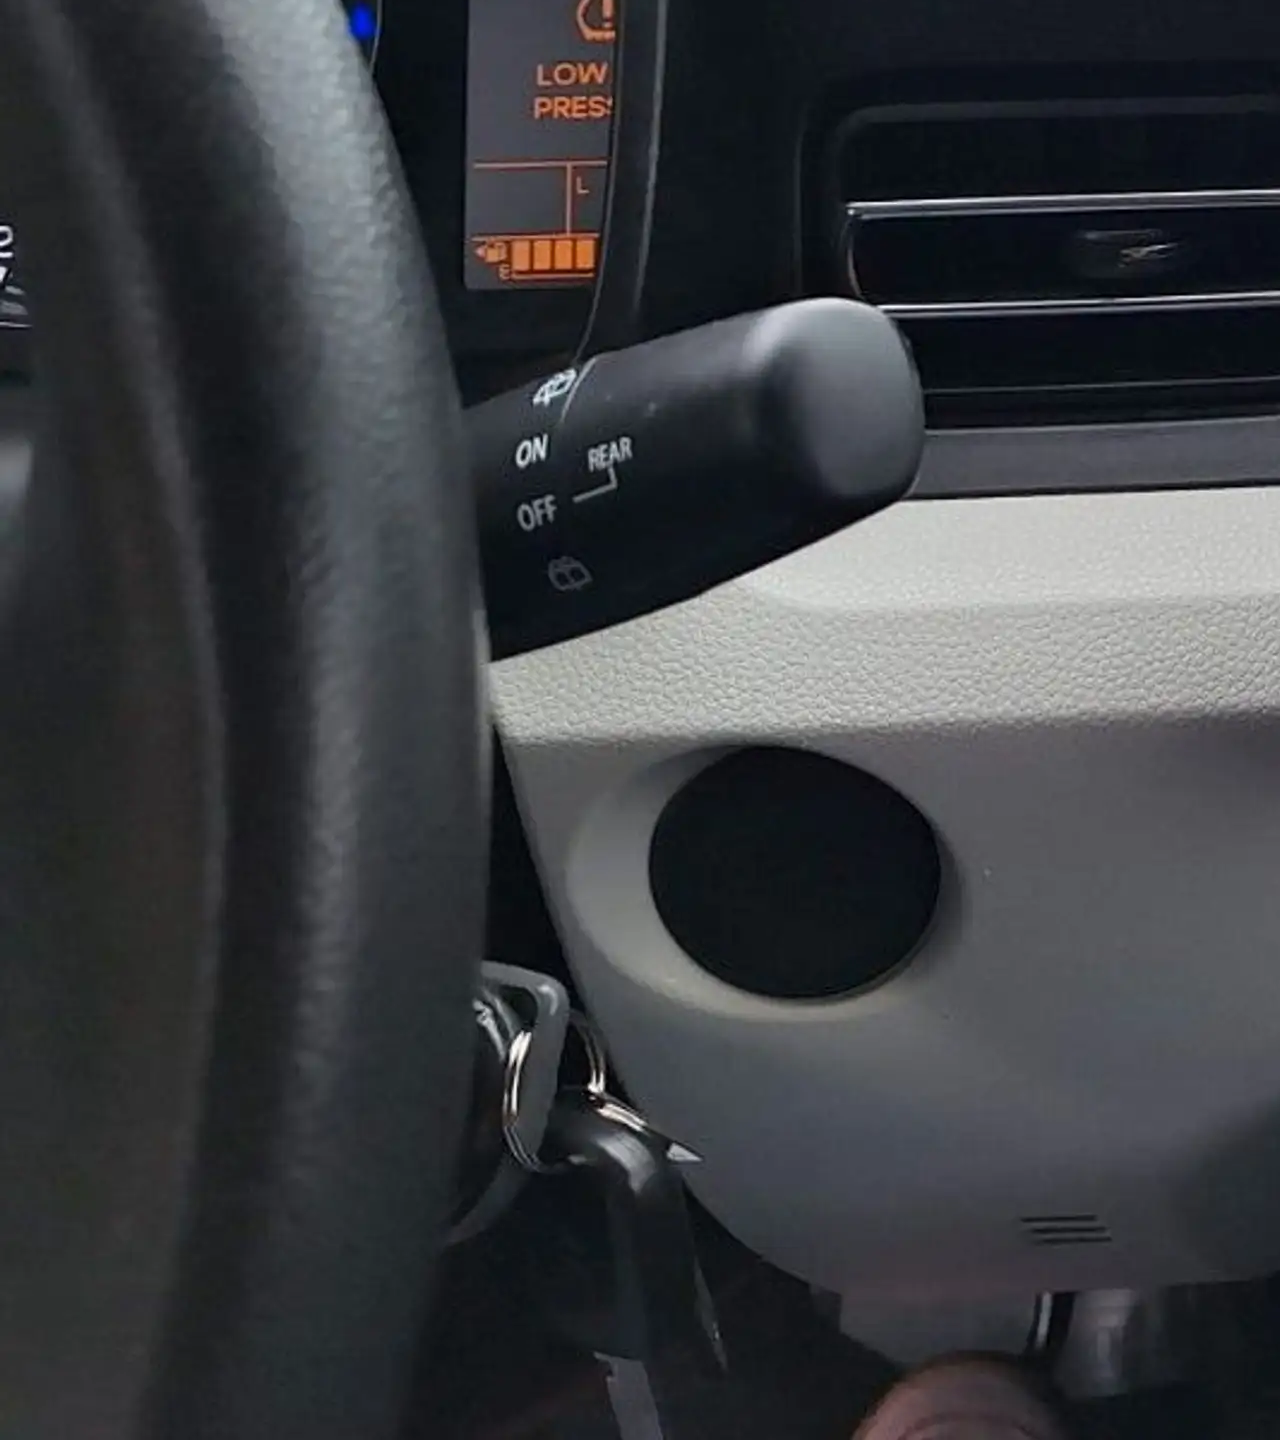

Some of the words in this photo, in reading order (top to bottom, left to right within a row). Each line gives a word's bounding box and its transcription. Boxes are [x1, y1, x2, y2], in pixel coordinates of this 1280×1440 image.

[537, 63, 607, 85] LOW
[576, 176, 589, 194] L
[516, 434, 548, 467] ON
[588, 437, 632, 472] REAR
[518, 495, 556, 530] OFF
